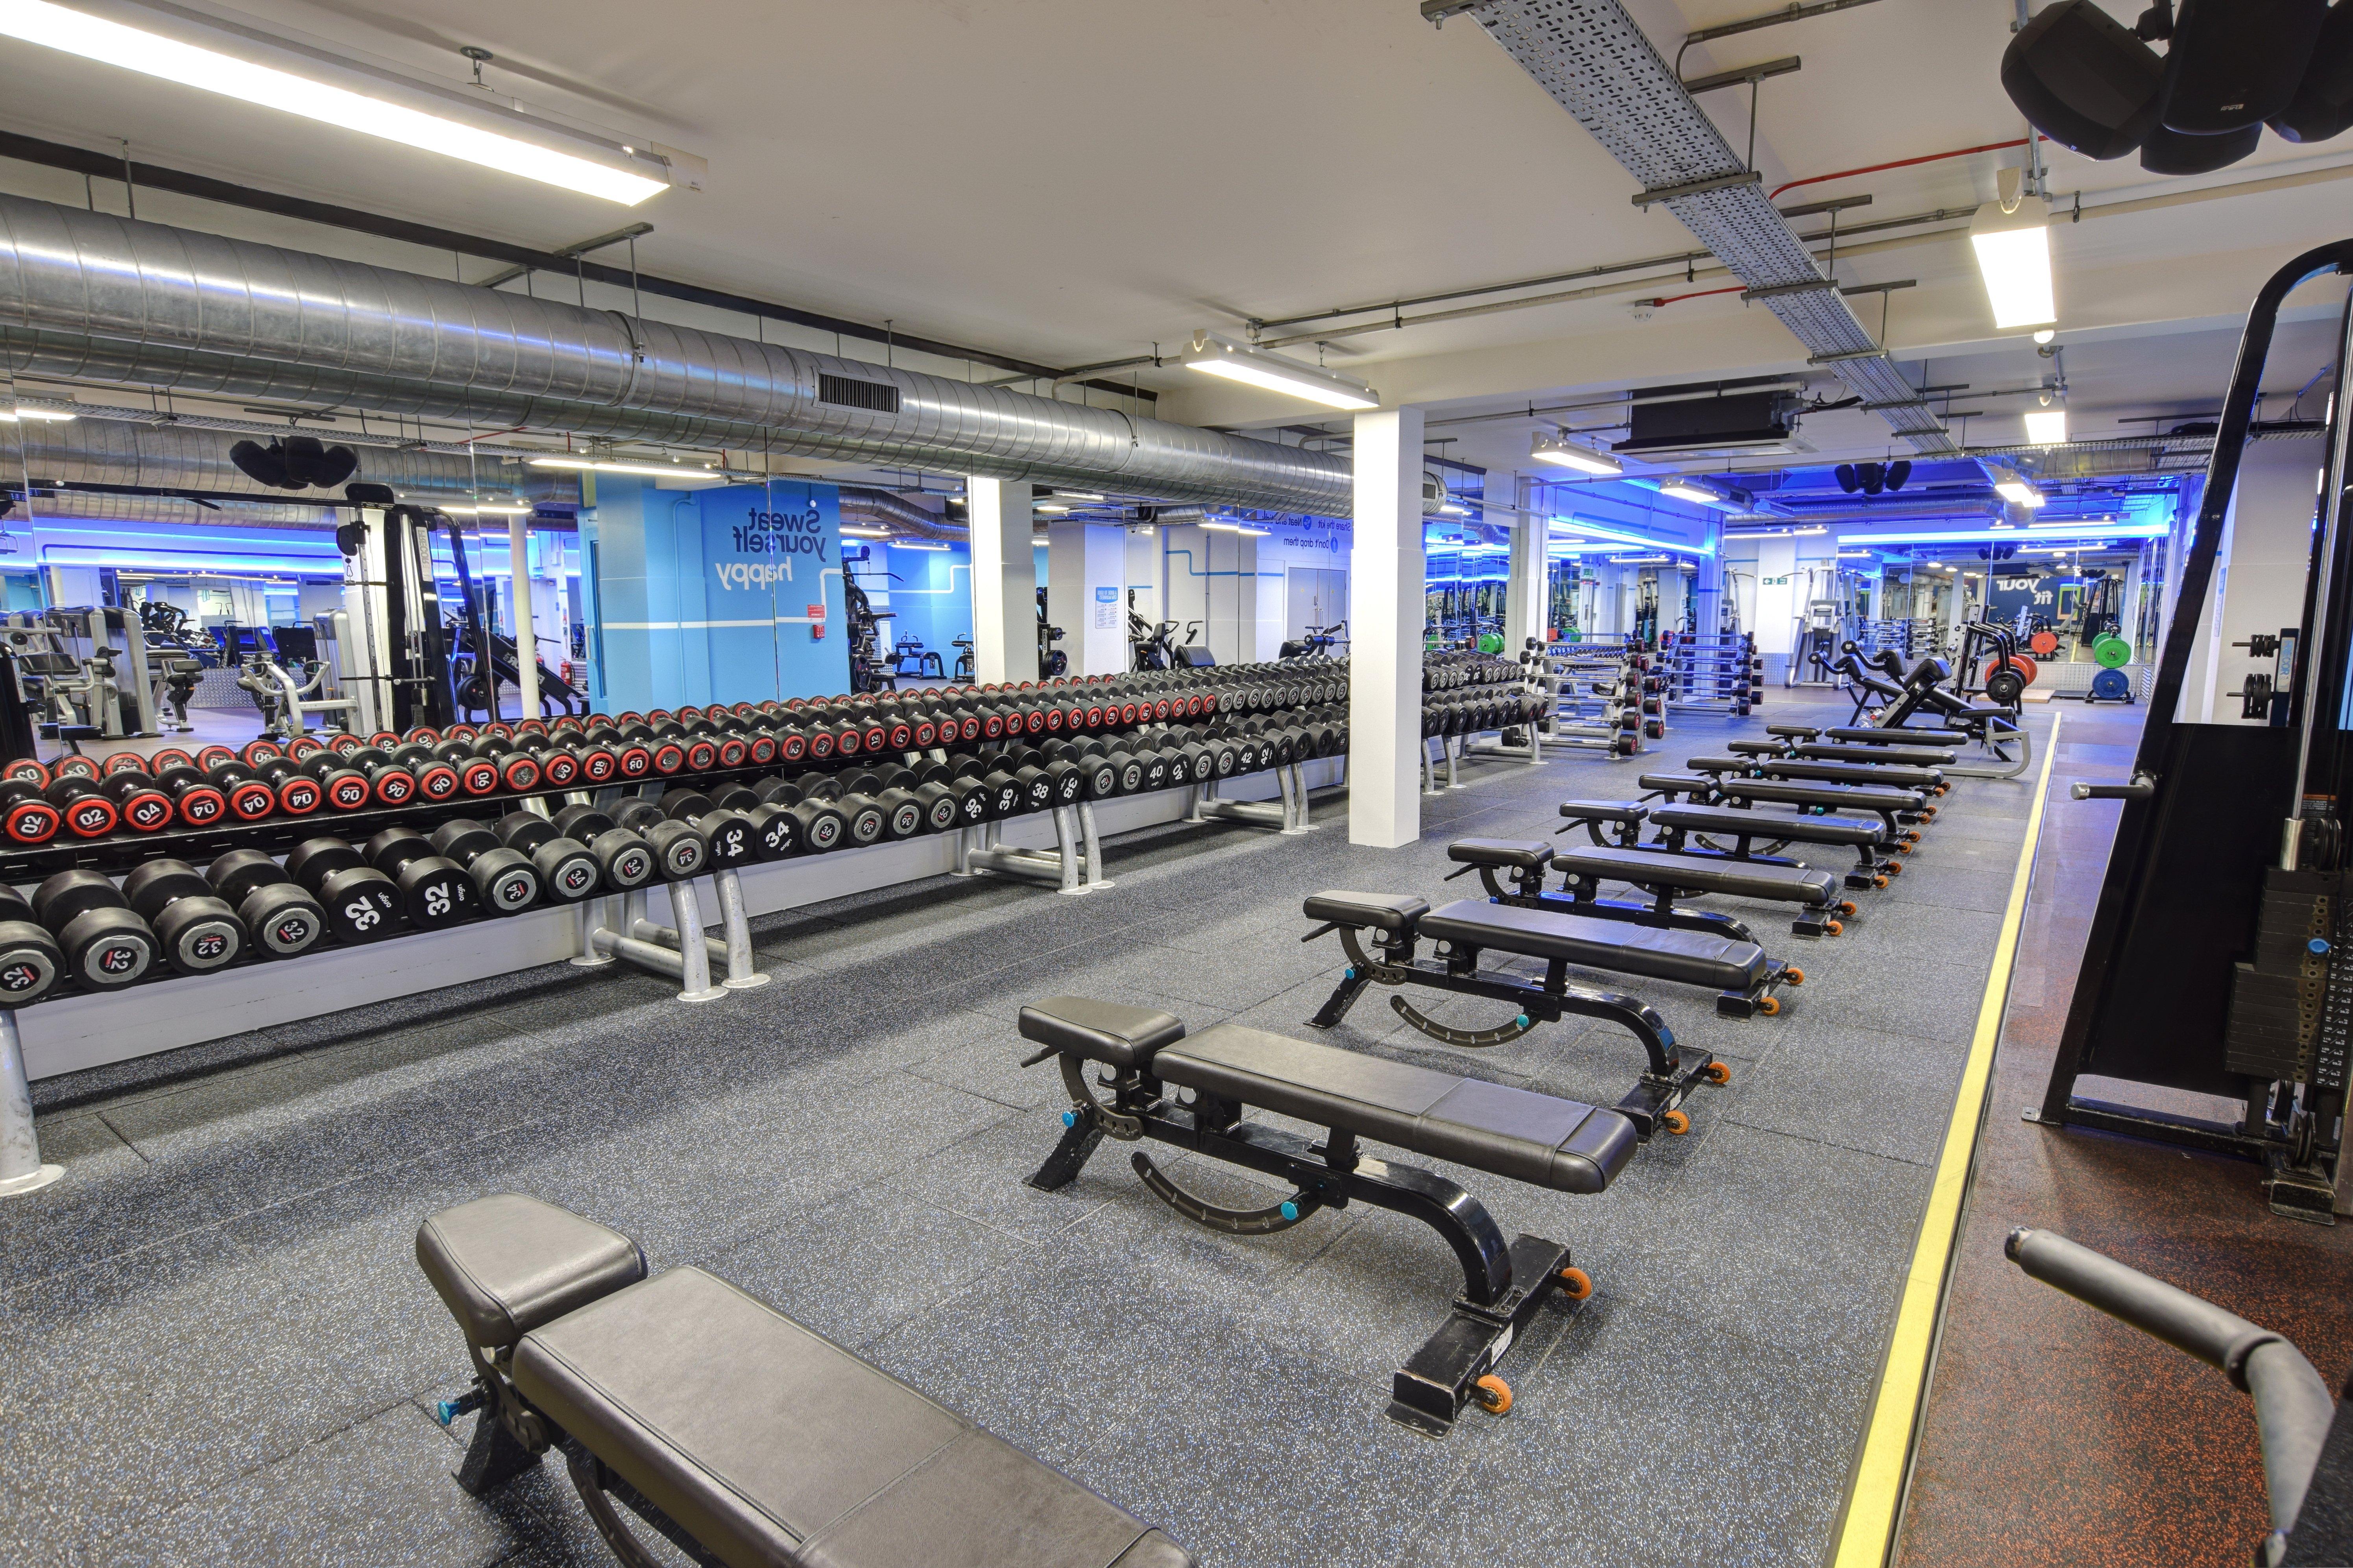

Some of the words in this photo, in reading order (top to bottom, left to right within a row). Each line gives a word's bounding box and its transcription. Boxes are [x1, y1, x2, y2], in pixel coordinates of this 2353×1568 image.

[872, 734, 879, 745] 12
[898, 734, 906, 743] 14
[1241, 753, 1252, 764] 42
[1261, 747, 1269, 765] 42
[594, 761, 605, 774] 08
[629, 760, 643, 770] 08
[1149, 765, 1164, 779] 40
[1173, 764, 1183, 780] 40
[1201, 762, 1206, 771] 40
[1101, 778, 1108, 788] 38
[1130, 773, 1136, 782] 38
[1032, 783, 1049, 799] 38
[1064, 777, 1078, 799] 38
[244, 797, 265, 813] 04
[292, 793, 312, 806] 04
[999, 788, 1013, 810] 36
[137, 803, 160, 820] 04
[194, 803, 215, 817] 04
[940, 808, 948, 818] 36
[965, 798, 982, 818] 36
[21, 815, 42, 834] 02
[80, 809, 105, 825] 02
[901, 817, 911, 826] 36
[765, 821, 790, 848] 34
[822, 826, 832, 836] 36
[863, 823, 874, 833] 36
[726, 829, 744, 857] 34
[780, 838, 792, 850] origin
[679, 852, 693, 865] 34
[628, 860, 641, 873] 34
[571, 870, 585, 885] 34
[425, 882, 451, 916] 32
[506, 884, 521, 900] 34
[378, 892, 392, 908] origin
[345, 896, 380, 931] 32
[284, 921, 305, 940] 32
[198, 941, 222, 955] 32
[111, 950, 131, 970] 32
[3, 967, 30, 989] 32
